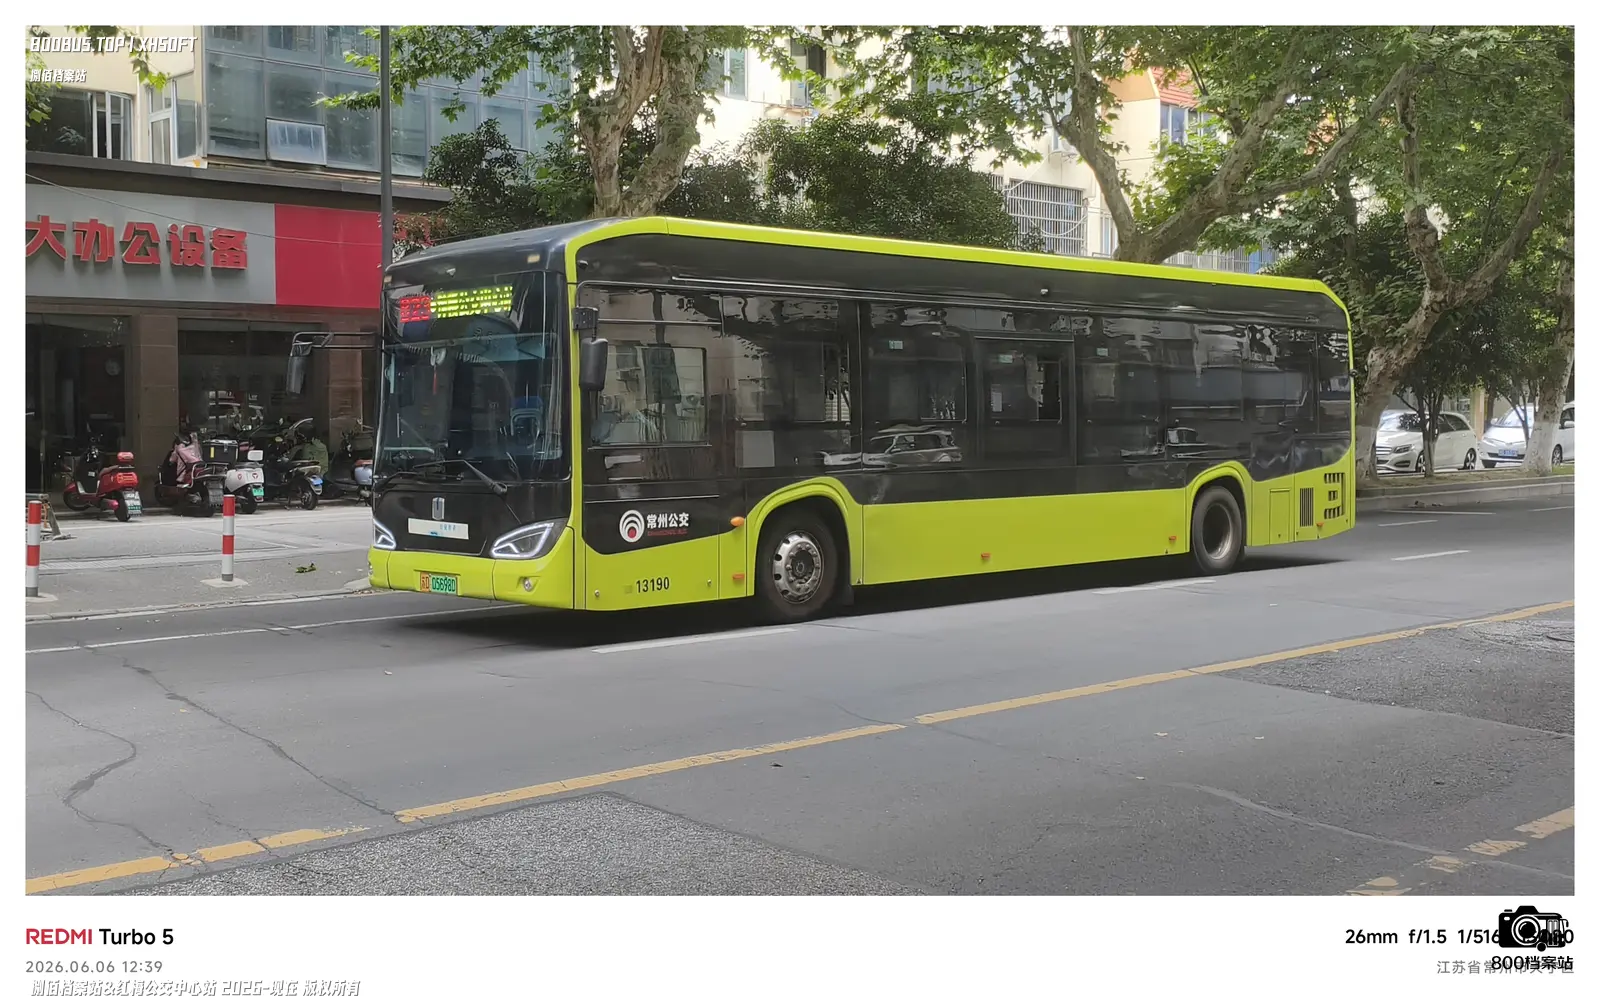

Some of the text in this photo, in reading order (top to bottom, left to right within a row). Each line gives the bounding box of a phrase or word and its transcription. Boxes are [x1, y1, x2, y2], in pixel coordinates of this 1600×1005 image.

[26, 215, 249, 269] 大办公设备
[646, 512, 690, 529] 常州公交
[636, 576, 670, 593] 13190
